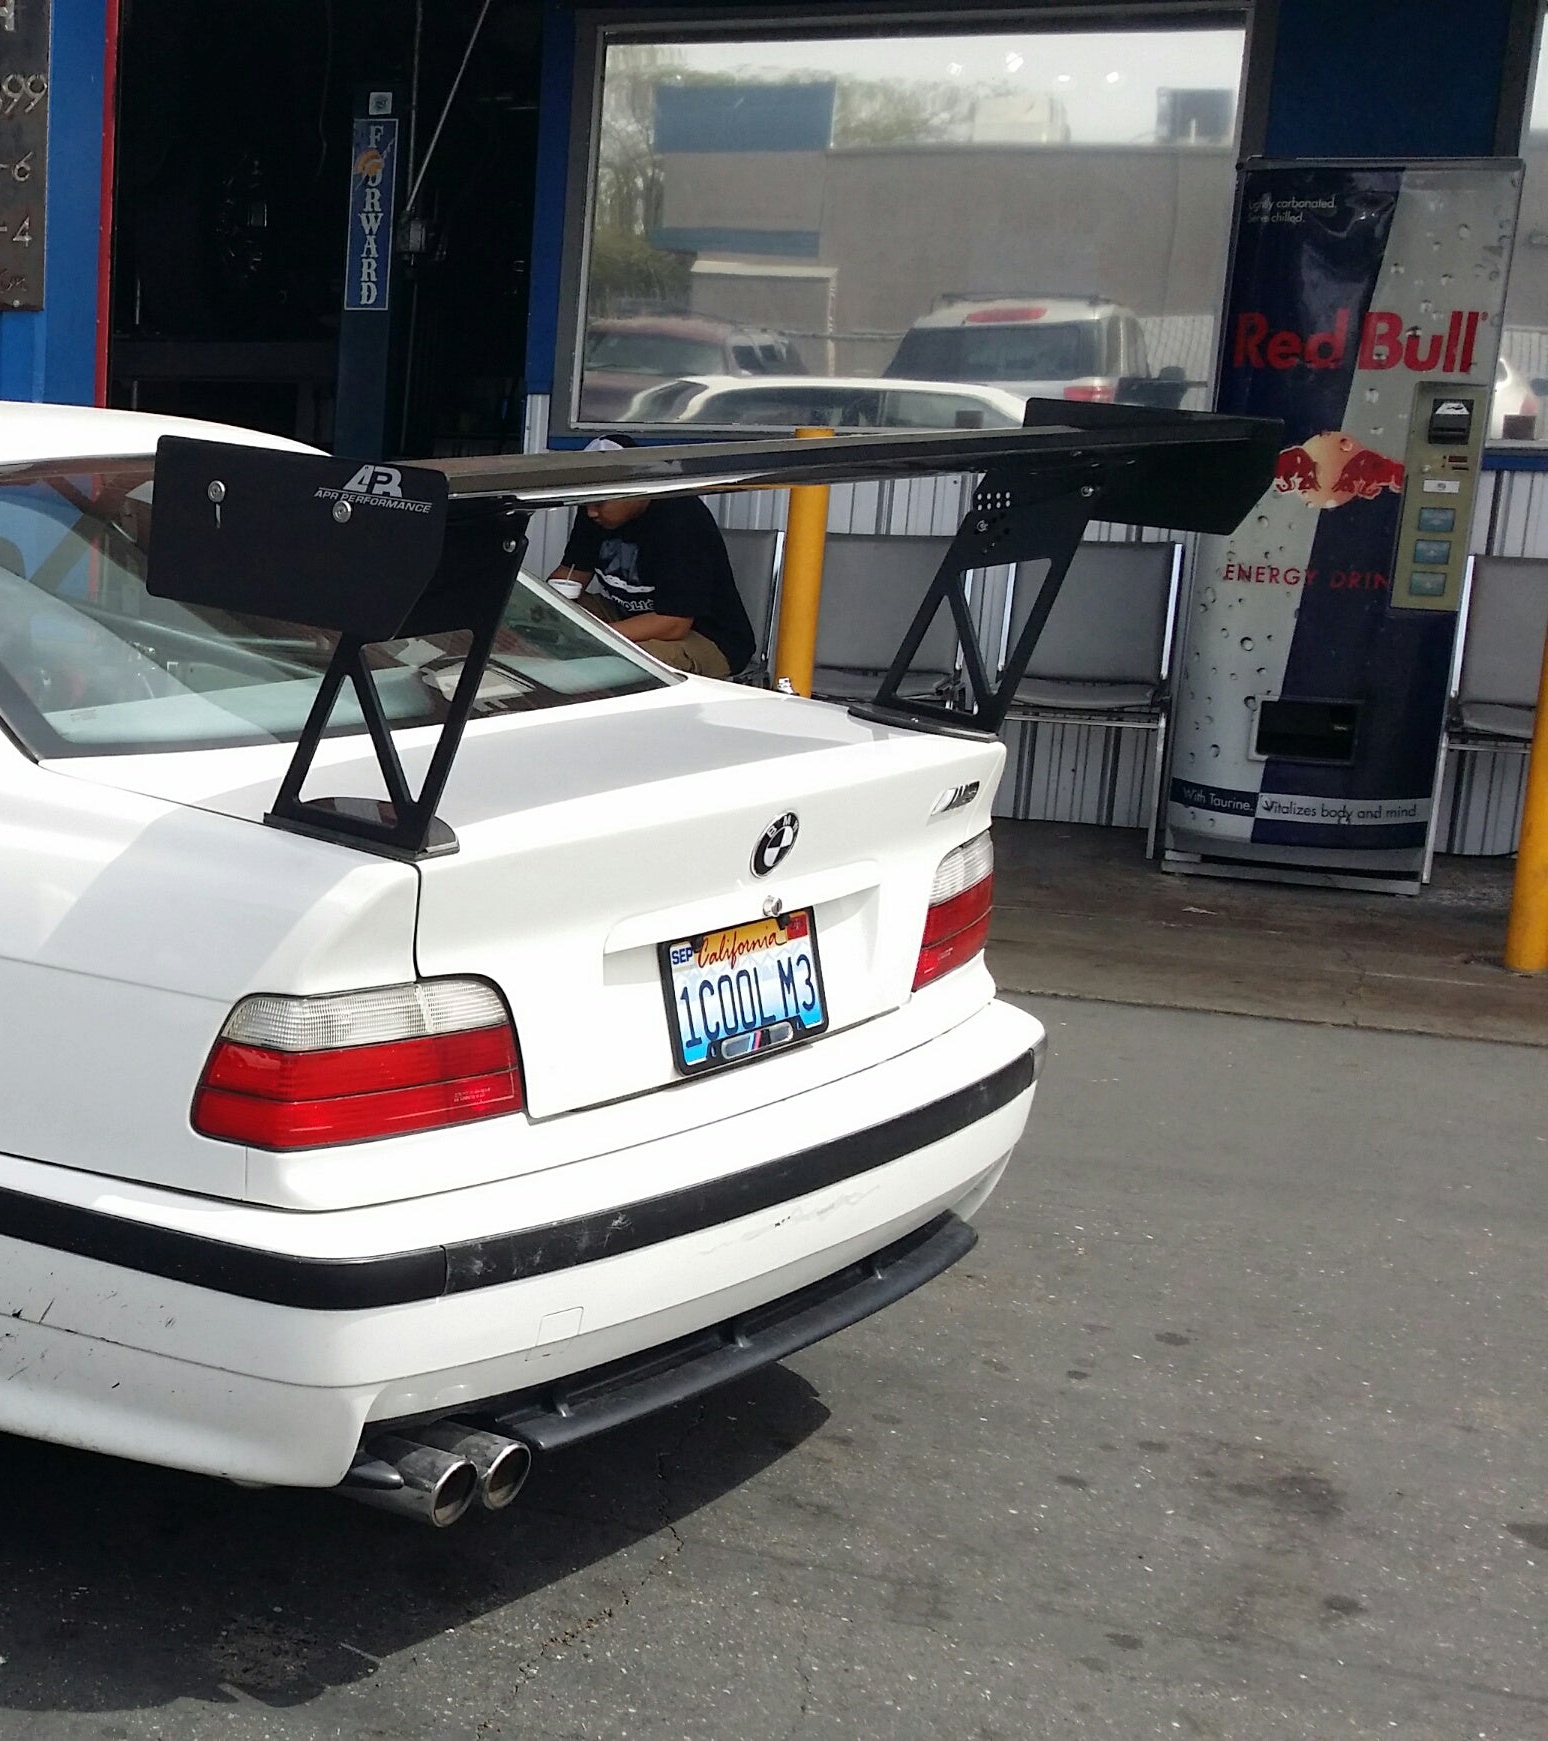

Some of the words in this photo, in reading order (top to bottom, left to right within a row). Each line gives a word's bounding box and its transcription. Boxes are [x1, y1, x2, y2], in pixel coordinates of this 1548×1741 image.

[1233, 308, 1350, 369] Red
[1358, 310, 1480, 373] Bull
[314, 489, 339, 500] APR
[340, 492, 432, 514] PERFORMANCE
[1224, 564, 1319, 586] ENERGY
[1330, 569, 1389, 589] DRIN
[1181, 786, 1206, 803] With
[1263, 800, 1317, 817] Vitalizes
[1321, 804, 1352, 823] body
[1357, 805, 1382, 819] and
[671, 946, 693, 965] SEP
[696, 930, 787, 970] California
[680, 967, 776, 1049] 1COOL
[777, 954, 816, 1018] M3
